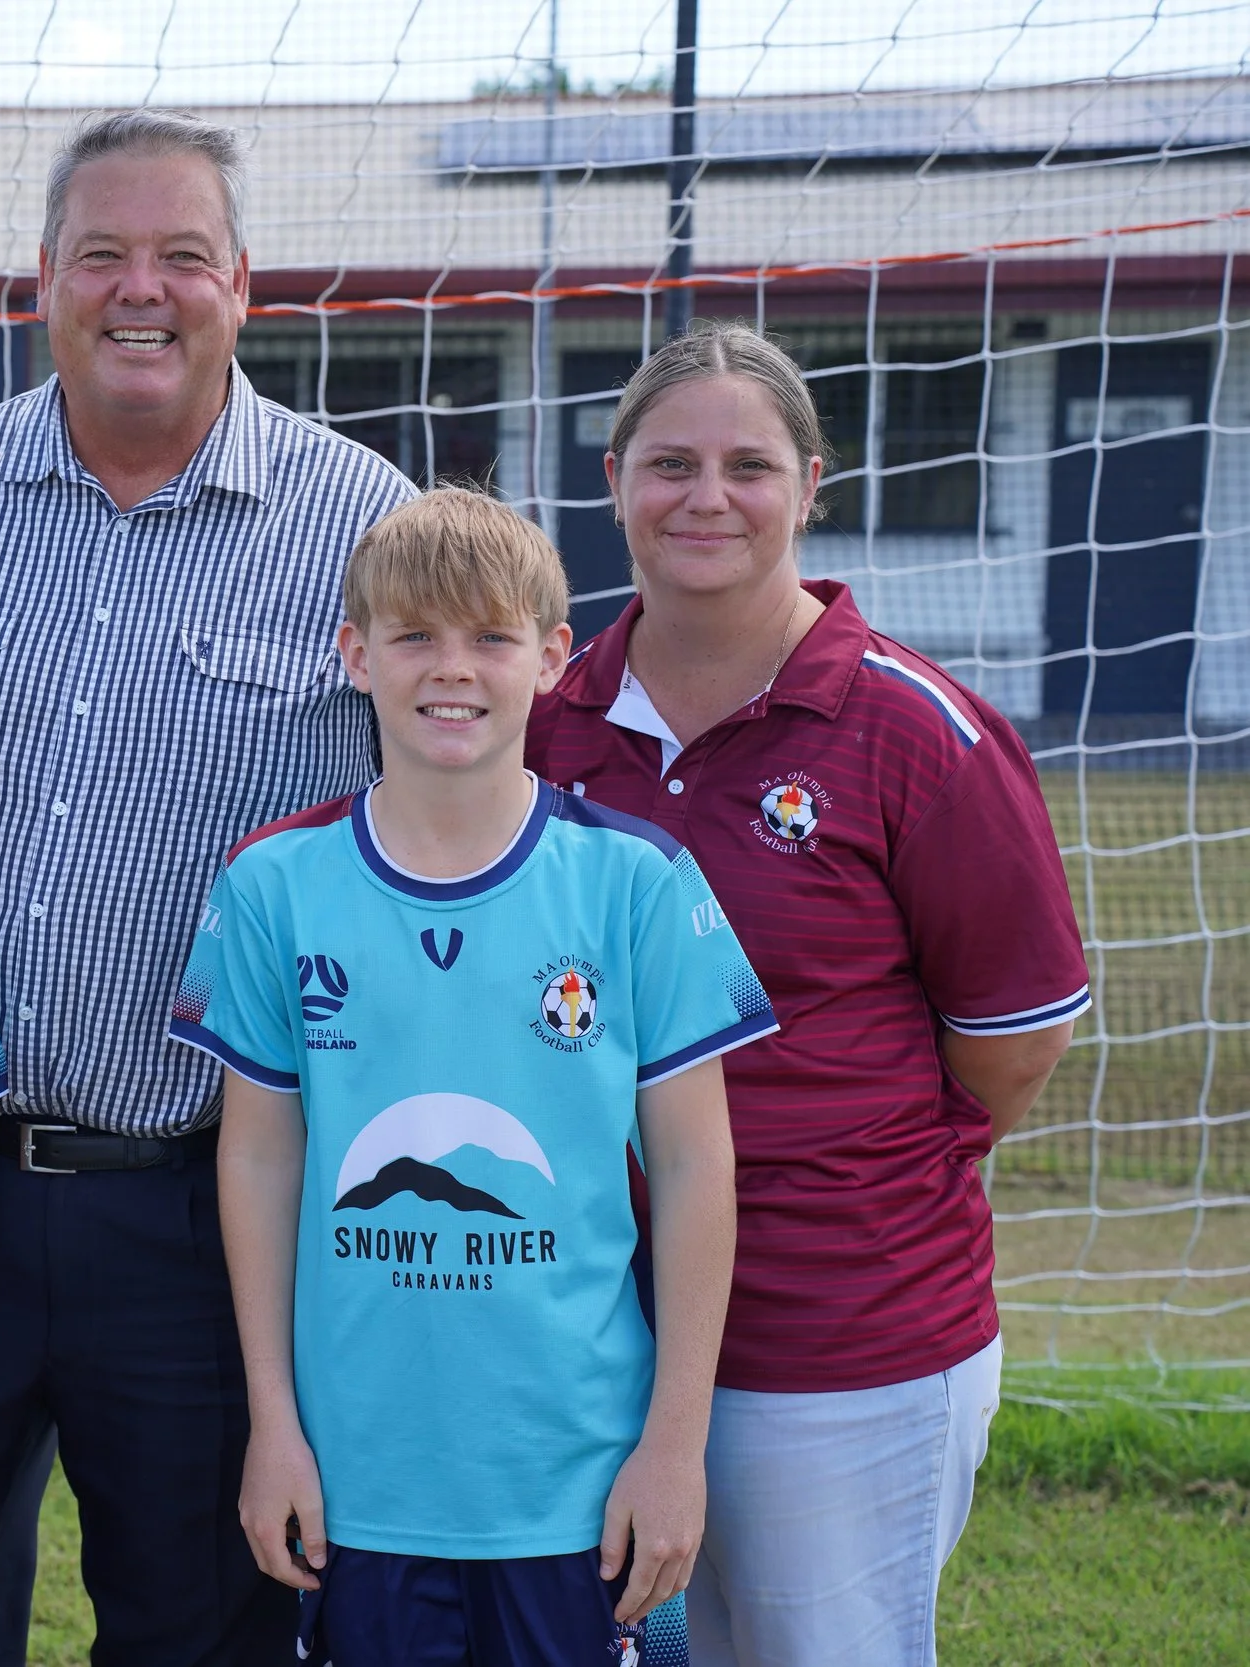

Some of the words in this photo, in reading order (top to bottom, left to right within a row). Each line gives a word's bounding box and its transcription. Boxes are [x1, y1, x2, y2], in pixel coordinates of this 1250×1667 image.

[758, 776, 783, 791] MA
[787, 771, 832, 810] Olympic
[749, 819, 799, 854] Football
[532, 963, 557, 984] MA
[560, 954, 606, 986] Olympic
[304, 1029, 344, 1039] OTBALL
[529, 1019, 583, 1053] Football
[588, 1021, 606, 1048] Club
[334, 1226, 438, 1265] SNOWY
[465, 1230, 557, 1265] RIVER
[392, 1271, 493, 1290] CARAVANS
